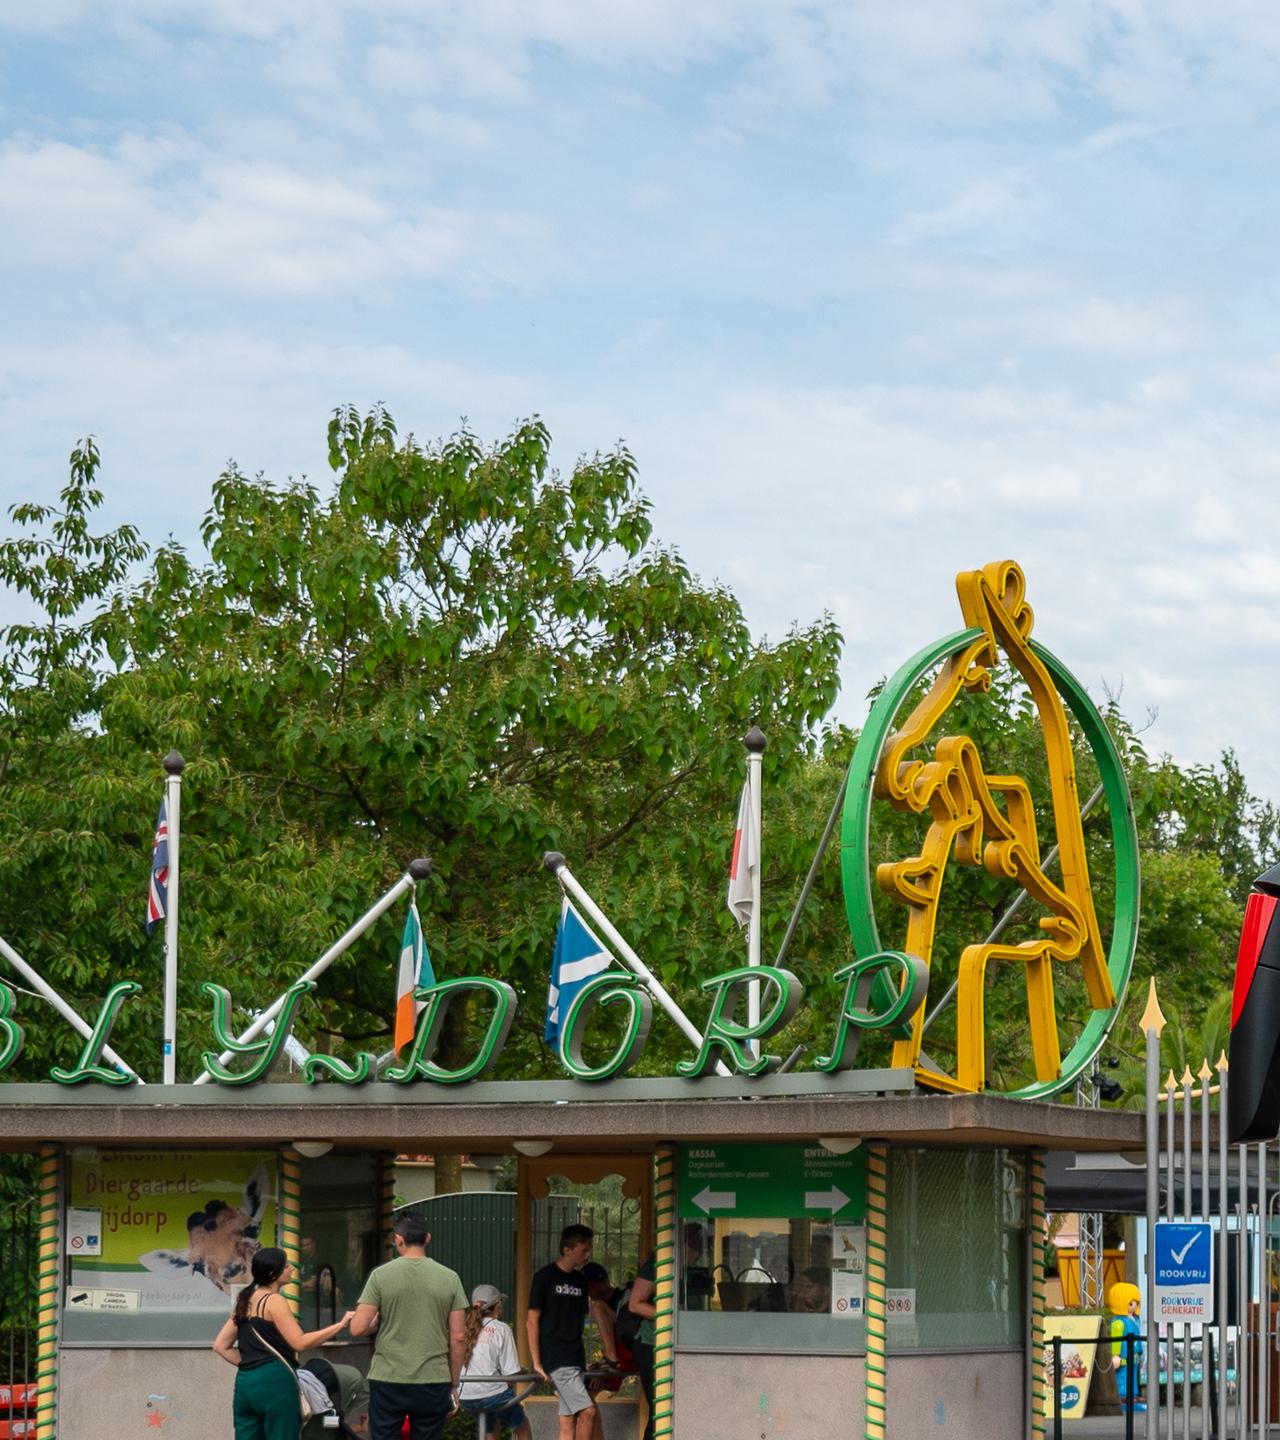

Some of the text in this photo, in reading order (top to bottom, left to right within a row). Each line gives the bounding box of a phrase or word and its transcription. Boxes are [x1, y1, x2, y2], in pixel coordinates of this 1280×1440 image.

[688, 1150, 716, 1158] KASSA
[85, 1172, 200, 1201] Diergaarde
[105, 1205, 167, 1233] ijdorp
[1159, 1269, 1207, 1279] ROOKVRIJ
[555, 1284, 583, 1296] adidas
[1161, 1296, 1204, 1306] ROOKVRIJE
[1161, 1306, 1205, 1316] GENERATIE
